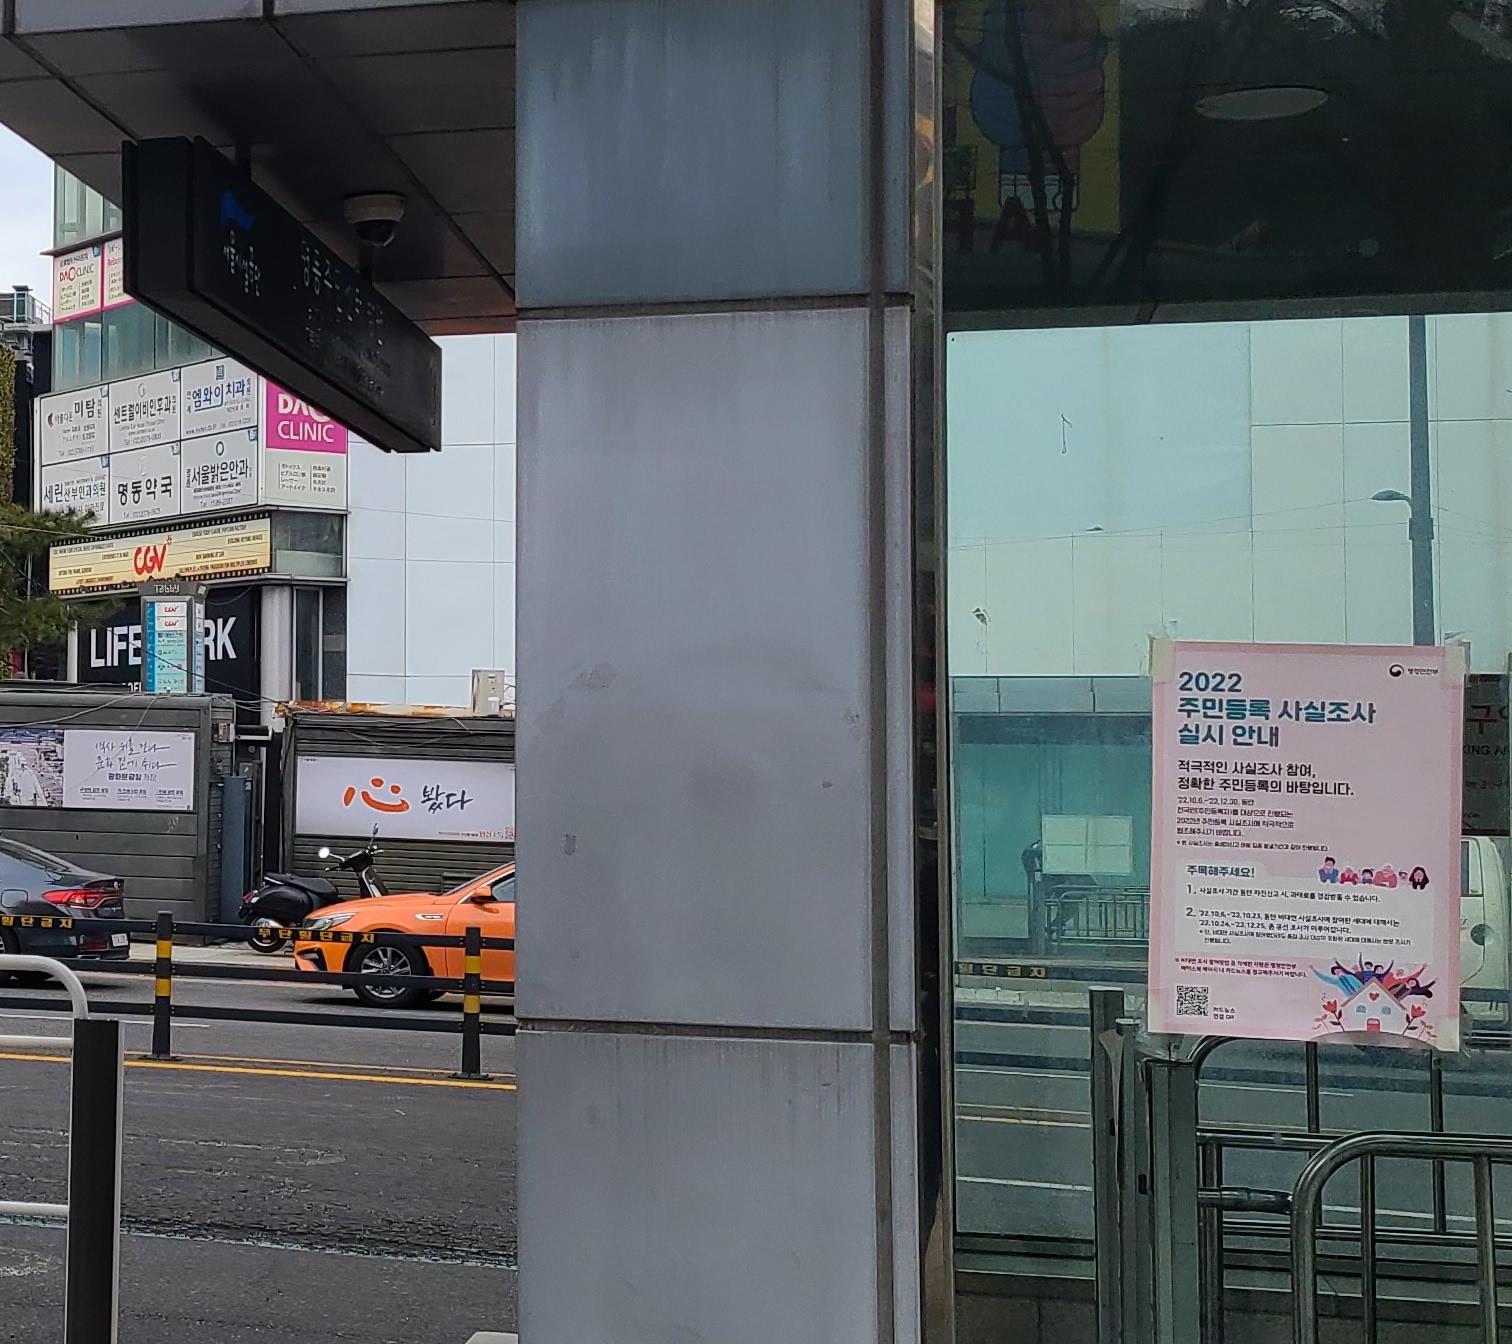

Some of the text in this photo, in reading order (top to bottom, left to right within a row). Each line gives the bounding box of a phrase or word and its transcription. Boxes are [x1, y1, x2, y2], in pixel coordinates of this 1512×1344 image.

[277, 421, 335, 443] CLINIC
[191, 457, 249, 486] 서울밝은안과
[117, 475, 173, 506] 명동약국
[133, 543, 167, 576] CGV
[1178, 670, 1243, 693] 2022
[1177, 697, 1377, 726] 주민등록 사실조사
[1178, 723, 1279, 748] 실시 안내
[1177, 759, 1316, 779] 적극적인 사실조사 참여,
[1177, 776, 1355, 796] 정확한 주민등록의 바탕입니다.
[1187, 864, 1256, 879] 주목해주세요!
[257, 926, 376, 945] 무단횡단금지
